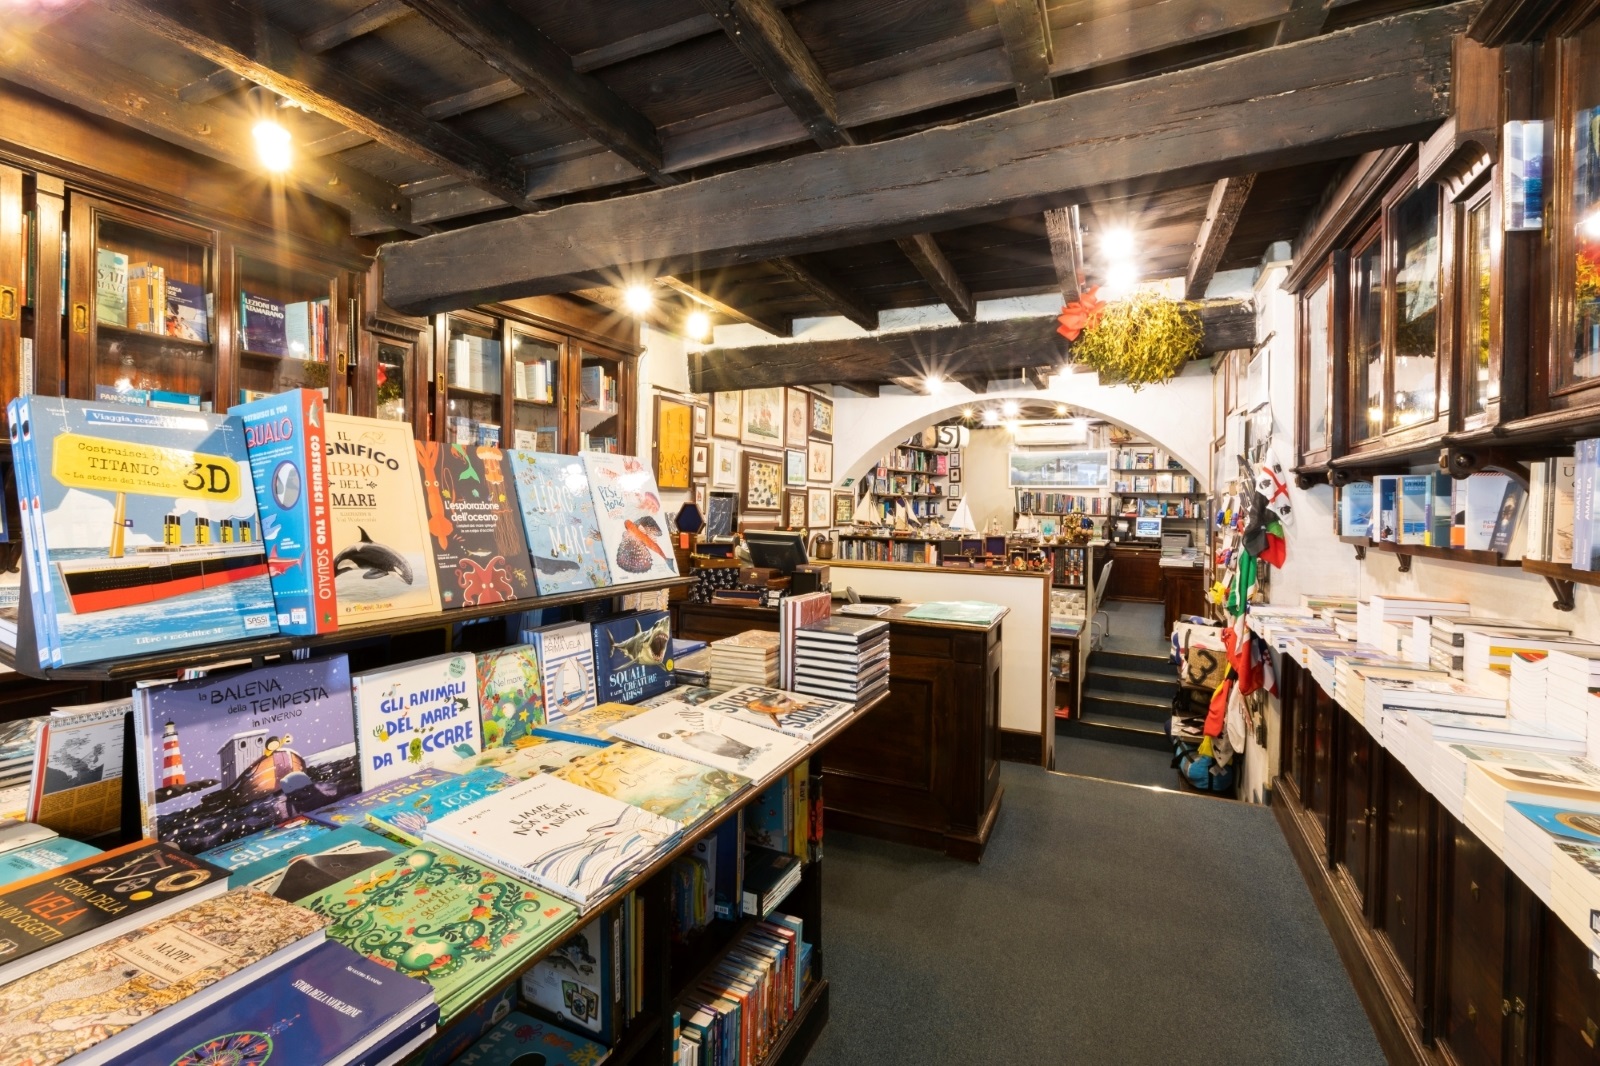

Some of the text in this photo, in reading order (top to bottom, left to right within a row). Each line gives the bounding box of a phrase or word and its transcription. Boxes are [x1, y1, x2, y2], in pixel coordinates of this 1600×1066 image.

[92, 412, 133, 424] Viaggia,
[244, 409, 269, 423] OSTRUISCI
[245, 417, 293, 448] QUALO
[337, 431, 352, 442] IL
[78, 442, 147, 459] Costruisci
[326, 442, 400, 471] GNIFICO
[88, 456, 159, 476] TITANIC
[73, 471, 171, 489] La storia del Titanic
[183, 463, 230, 493] 3D
[340, 479, 363, 490] DEL
[332, 493, 377, 507] MARE
[444, 500, 499, 511] L'esplorazione
[1584, 477, 1593, 520] AMALTEA
[311, 435, 332, 600] COSTRUISCI IL TUO SQUALO
[451, 513, 499, 522] dell'oceano
[549, 526, 590, 556] MARE
[136, 636, 161, 645] Libro
[170, 629, 211, 641] modellino
[565, 639, 582, 650] VELA
[493, 675, 523, 689] Nel mare
[609, 665, 646, 687] SQUALI
[623, 673, 658, 692] CREATURE
[199, 678, 282, 705] la BALENA
[228, 687, 329, 716] della TEMPESTA
[380, 681, 466, 714] GLI ANIMALI
[622, 687, 643, 702] ABISSI
[709, 686, 777, 714] SUPER
[252, 709, 303, 728] in INVERNO
[386, 703, 458, 737] DEL MARE
[779, 698, 840, 729] SQUALI
[373, 752, 393, 770] DA
[377, 780, 437, 803] mare
[440, 789, 481, 808] 1001
[513, 802, 573, 836] NON SERVE
[519, 803, 553, 820] MARE
[535, 807, 589, 837] A NIENTE
[53, 877, 128, 915] STORIA DELLA
[420, 894, 463, 920] gialla
[24, 890, 89, 926] VELA
[10, 914, 64, 943] OGGETTI
[153, 942, 196, 963] MAPPE
[291, 979, 363, 1018] STORIA DELLA NAVIGAZIONE
[460, 1019, 518, 1066] MARE
